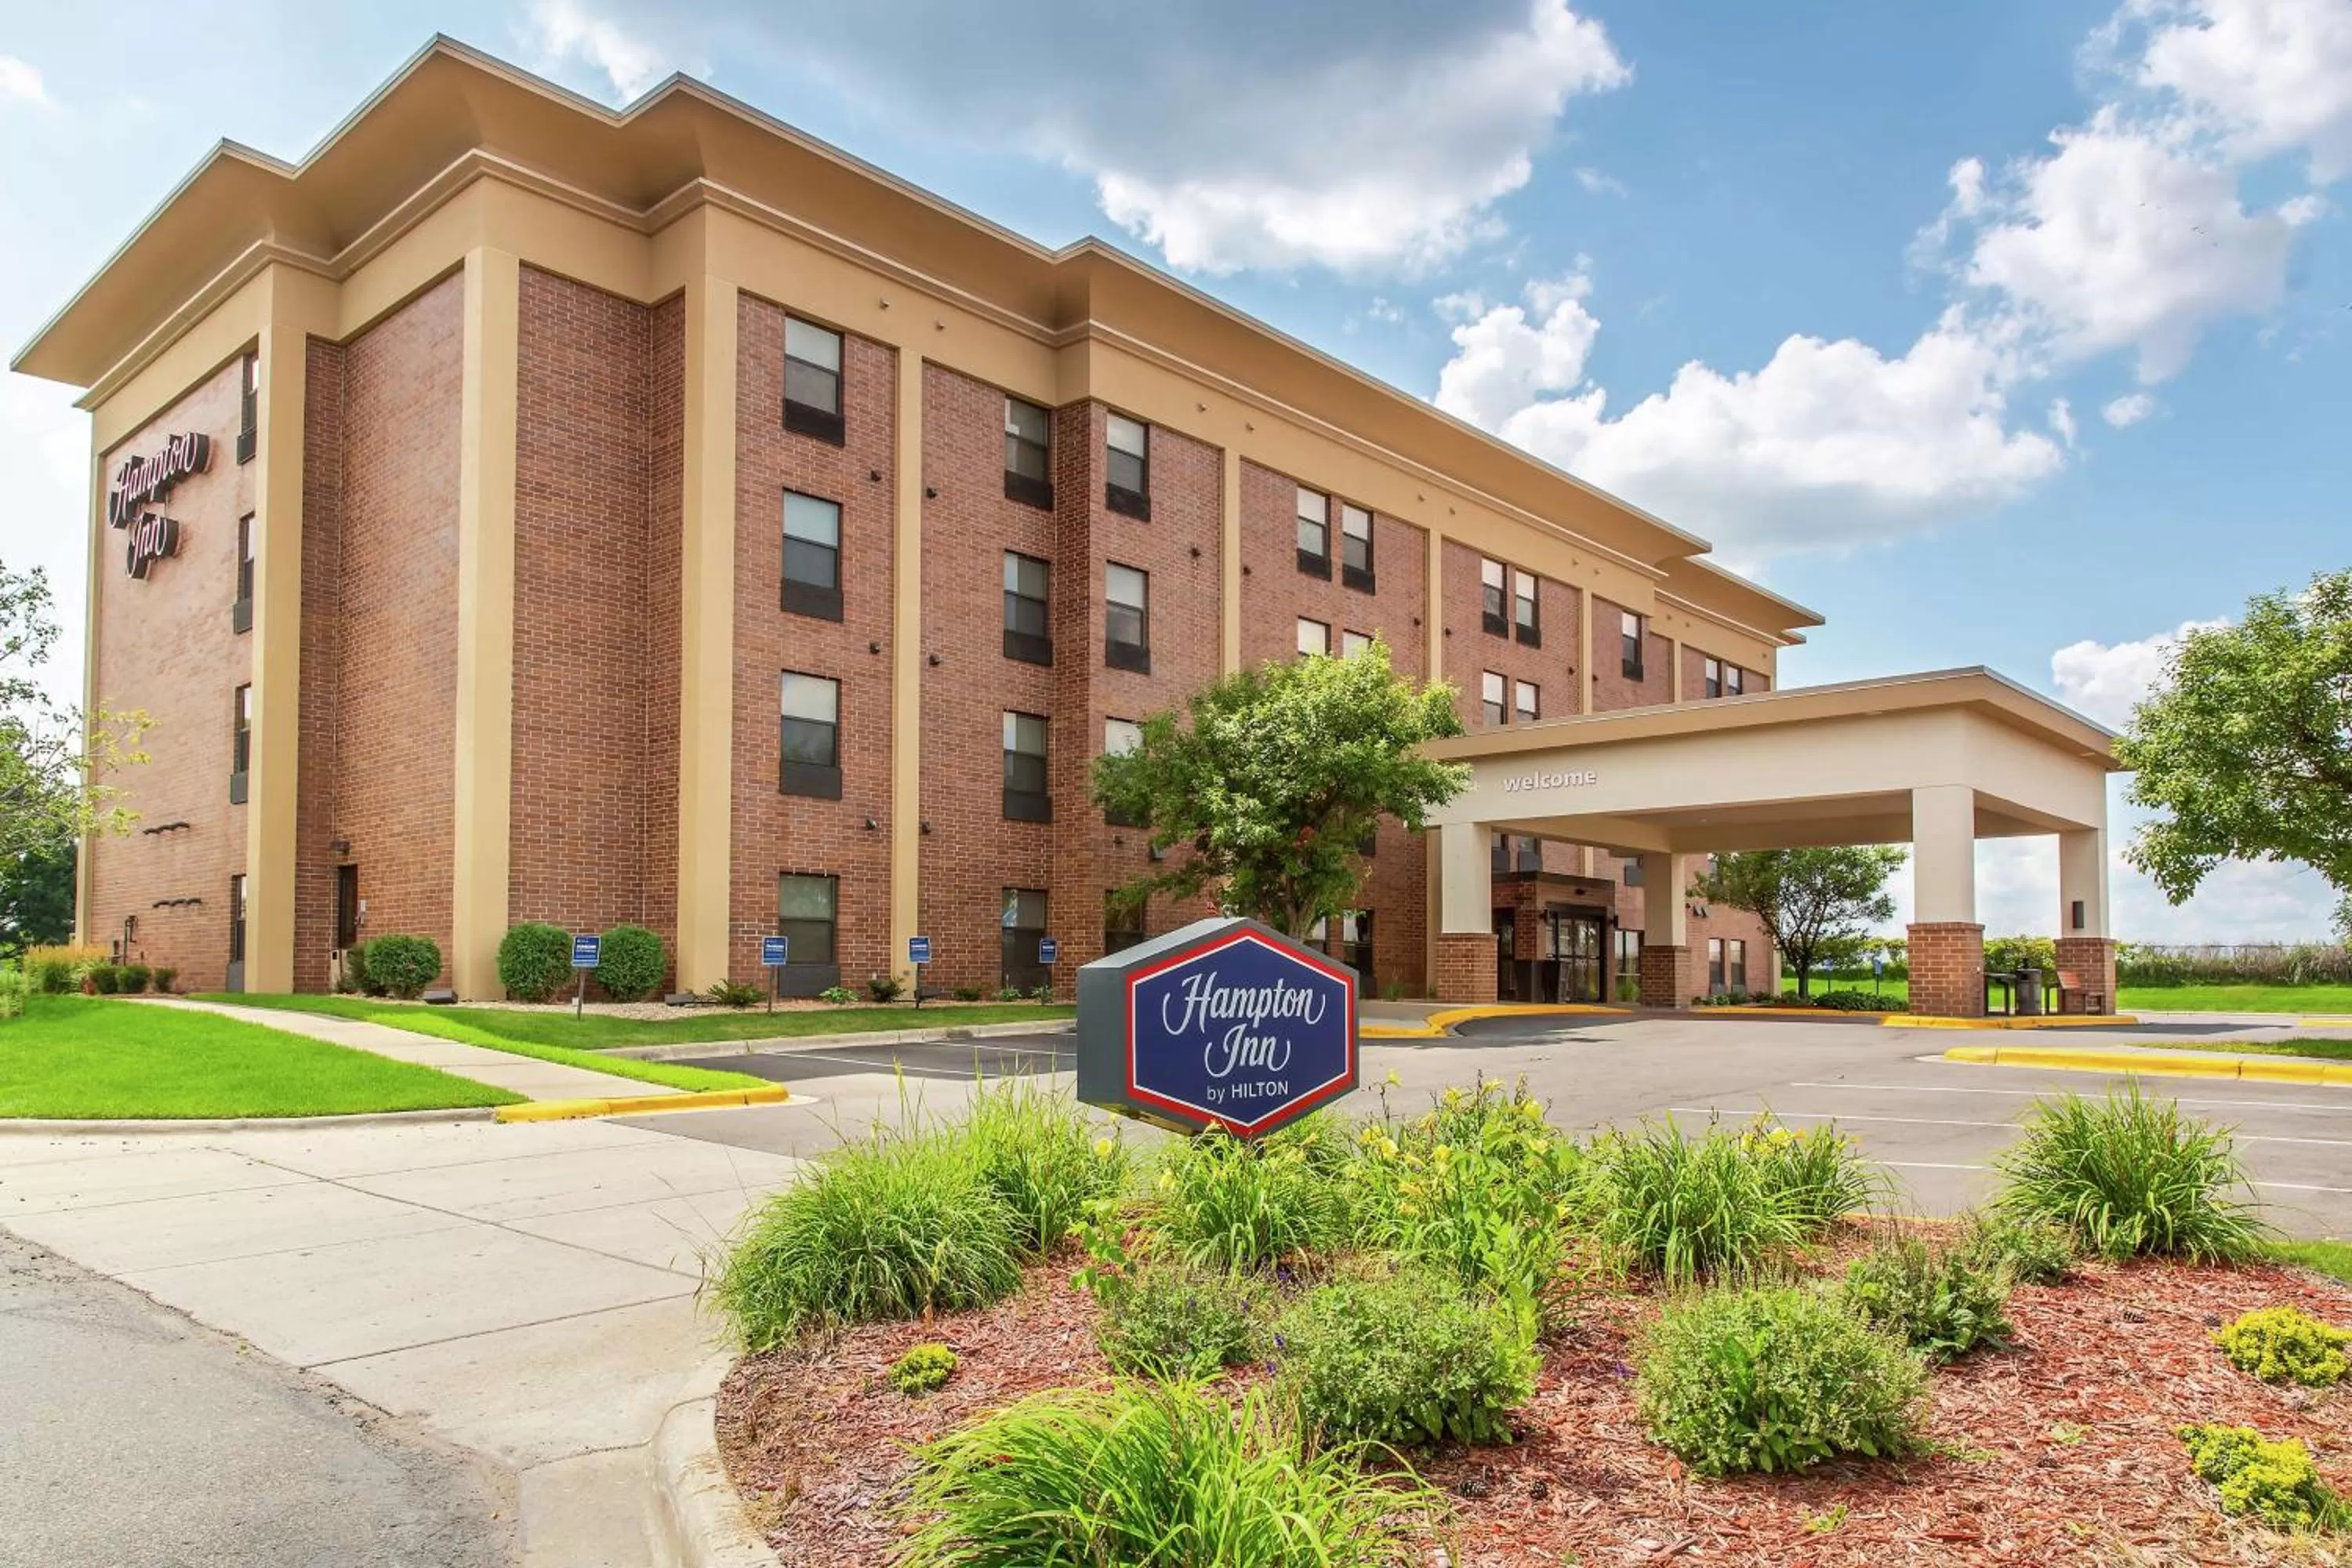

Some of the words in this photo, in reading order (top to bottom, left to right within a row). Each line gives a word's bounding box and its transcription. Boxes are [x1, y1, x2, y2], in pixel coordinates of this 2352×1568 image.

[109, 432, 204, 528] Hampton
[126, 511, 174, 579] Inn
[1503, 770, 1597, 792] welcome
[1162, 971, 1326, 1035] Hampton
[1204, 1023, 1290, 1078] Inn
[1207, 1085, 1225, 1104] by
[1232, 1080, 1289, 1099] HILTON
